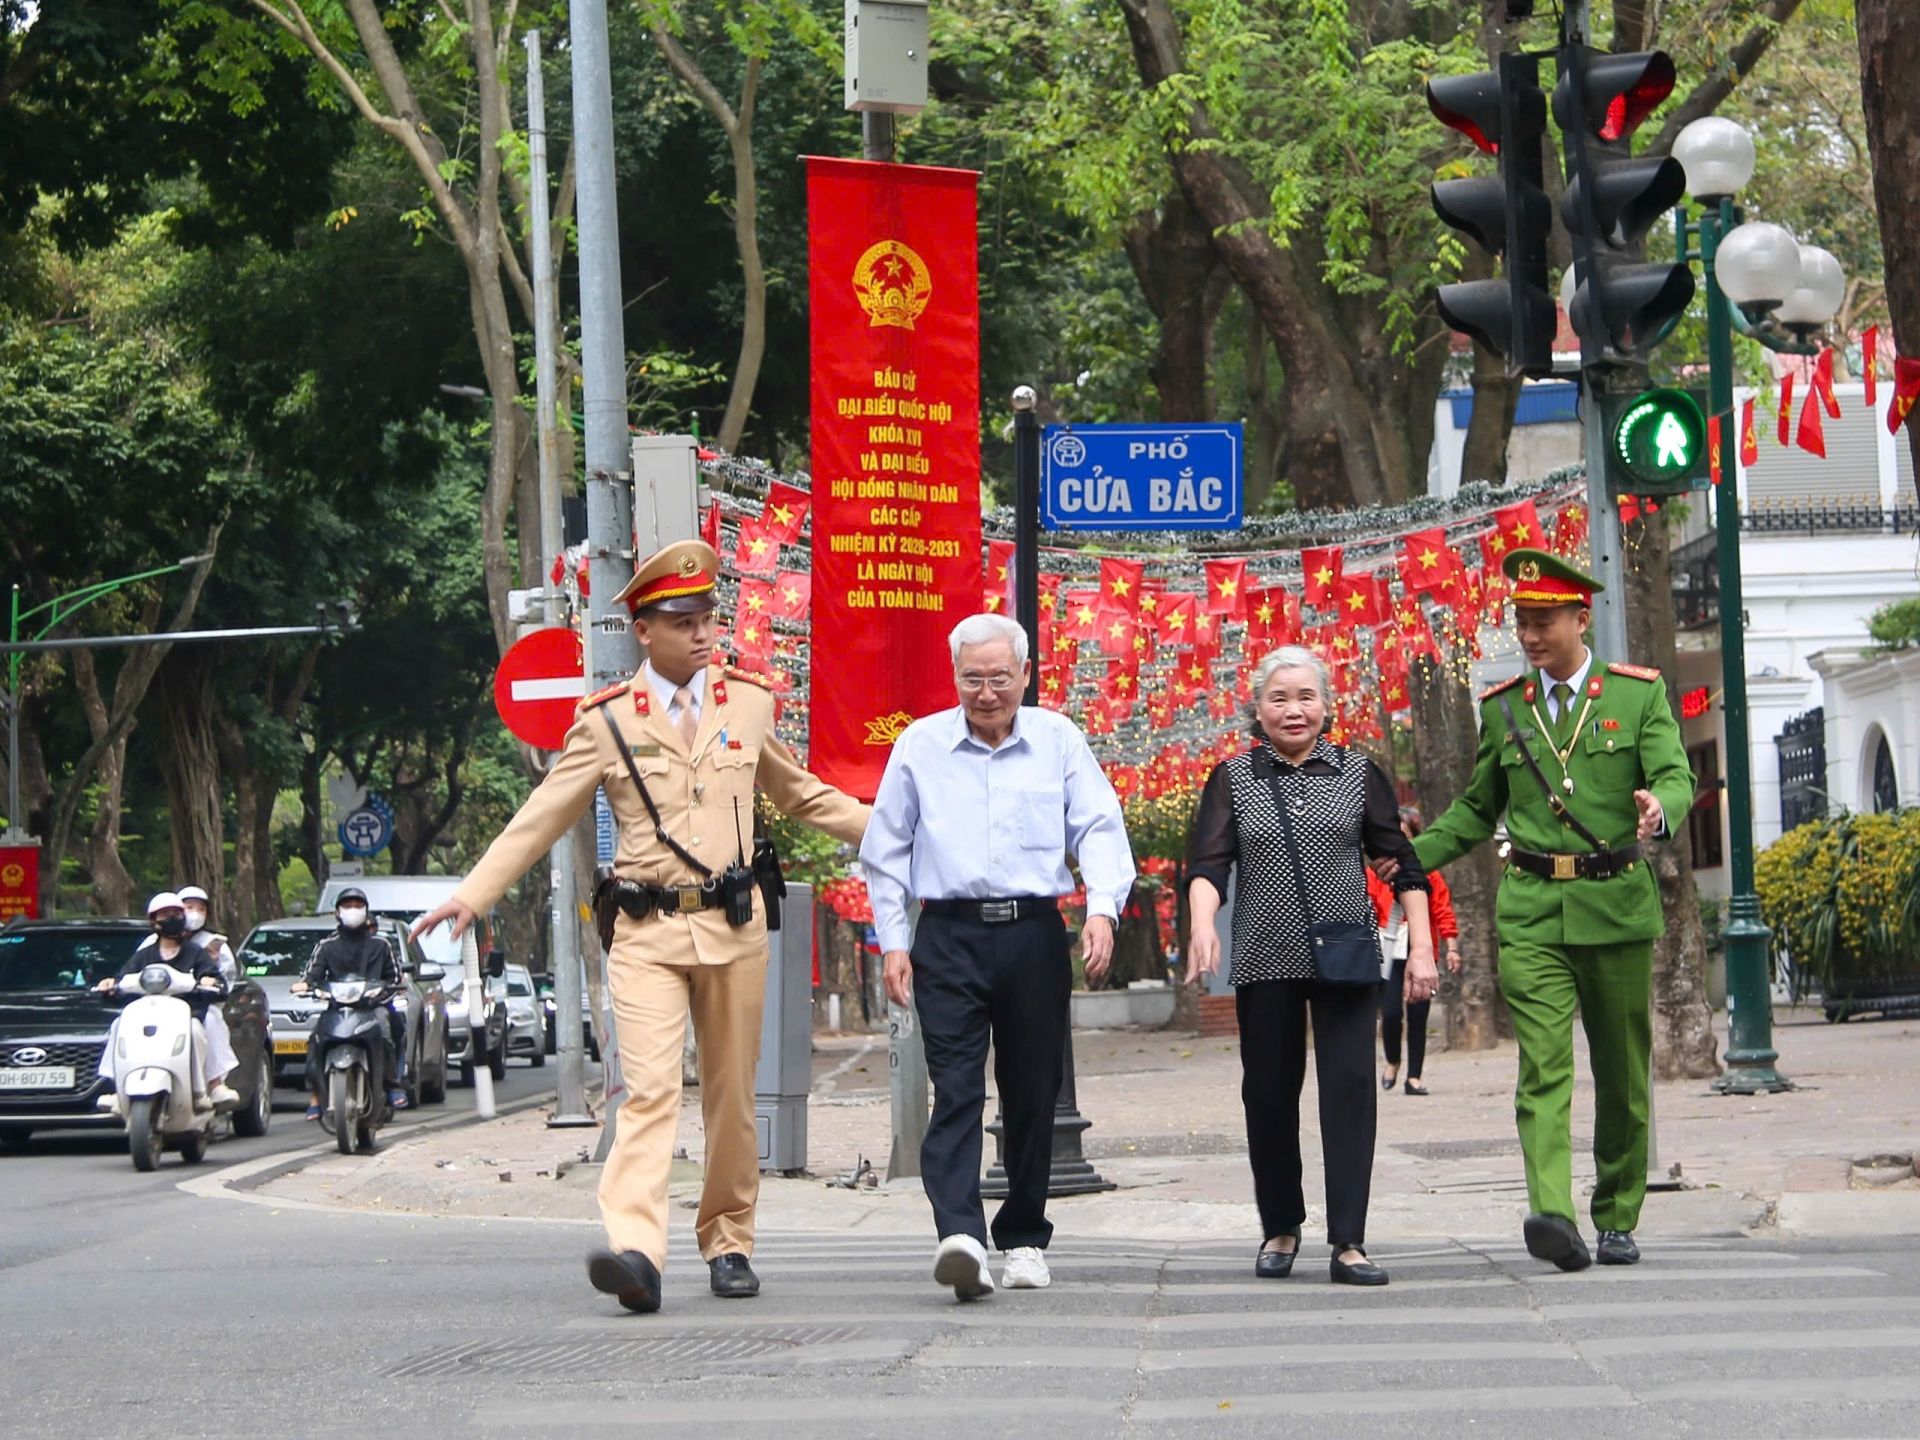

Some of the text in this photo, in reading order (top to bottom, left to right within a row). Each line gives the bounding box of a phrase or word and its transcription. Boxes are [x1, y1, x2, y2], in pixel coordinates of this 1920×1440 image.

[838, 392, 952, 425] ĐẠI BIỂU QUỐC HỘI
[868, 422, 922, 447] KHÓA XVI
[1129, 434, 1190, 459] PHỐ
[860, 450, 930, 475] VÀ ĐẠI BIỂU
[831, 477, 854, 501] HỘI
[929, 482, 958, 503] DÂN
[1059, 465, 1222, 513] CỬA BẮC
[870, 504, 921, 527] CÁC CẤP
[830, 531, 960, 557] NHIỆM KỲ 2026-2031
[857, 559, 934, 586] LÀ NGÀY HỘI
[847, 585, 944, 611] CỦA TOÀN DÂN!
